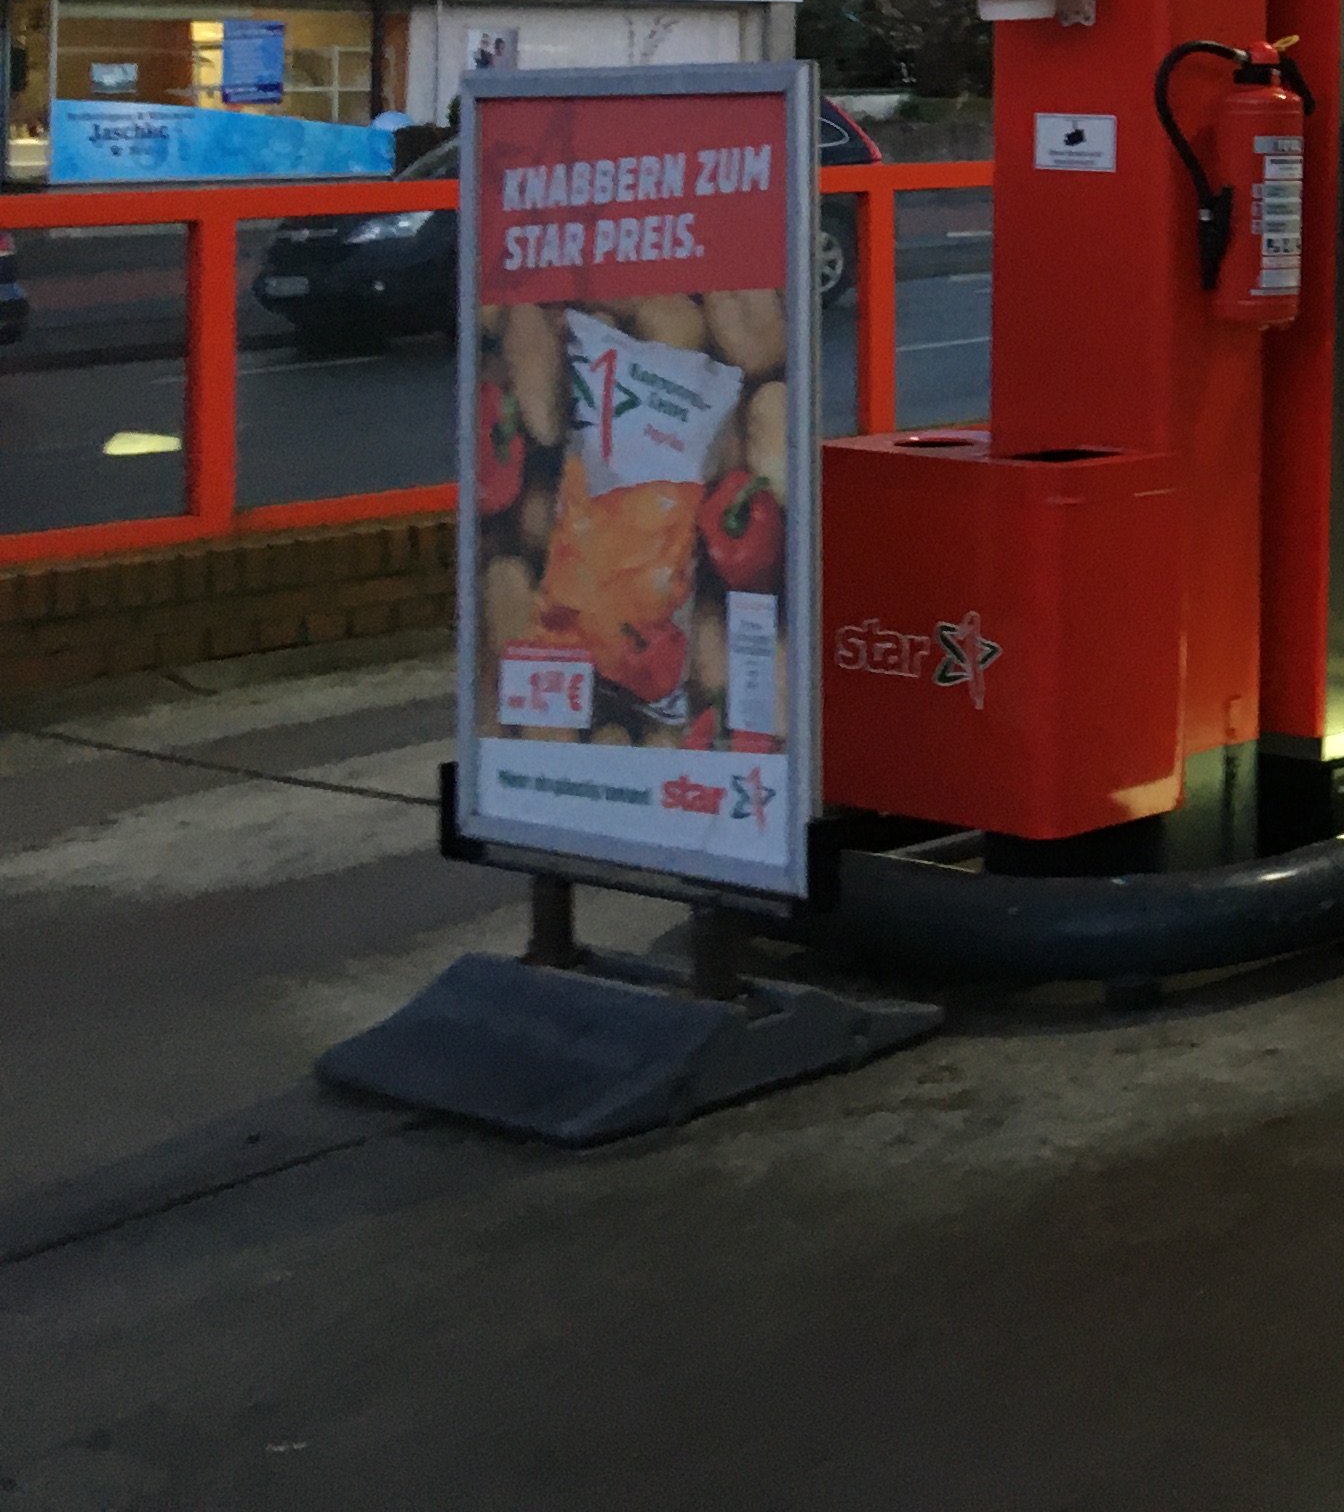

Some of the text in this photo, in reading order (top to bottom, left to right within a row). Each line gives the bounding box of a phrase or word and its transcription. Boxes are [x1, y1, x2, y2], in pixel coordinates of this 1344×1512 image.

[503, 144, 773, 212] KNABBERN ZUM
[503, 213, 705, 271] STAR PREIS.
[833, 618, 930, 678] star
[662, 774, 725, 815] star
